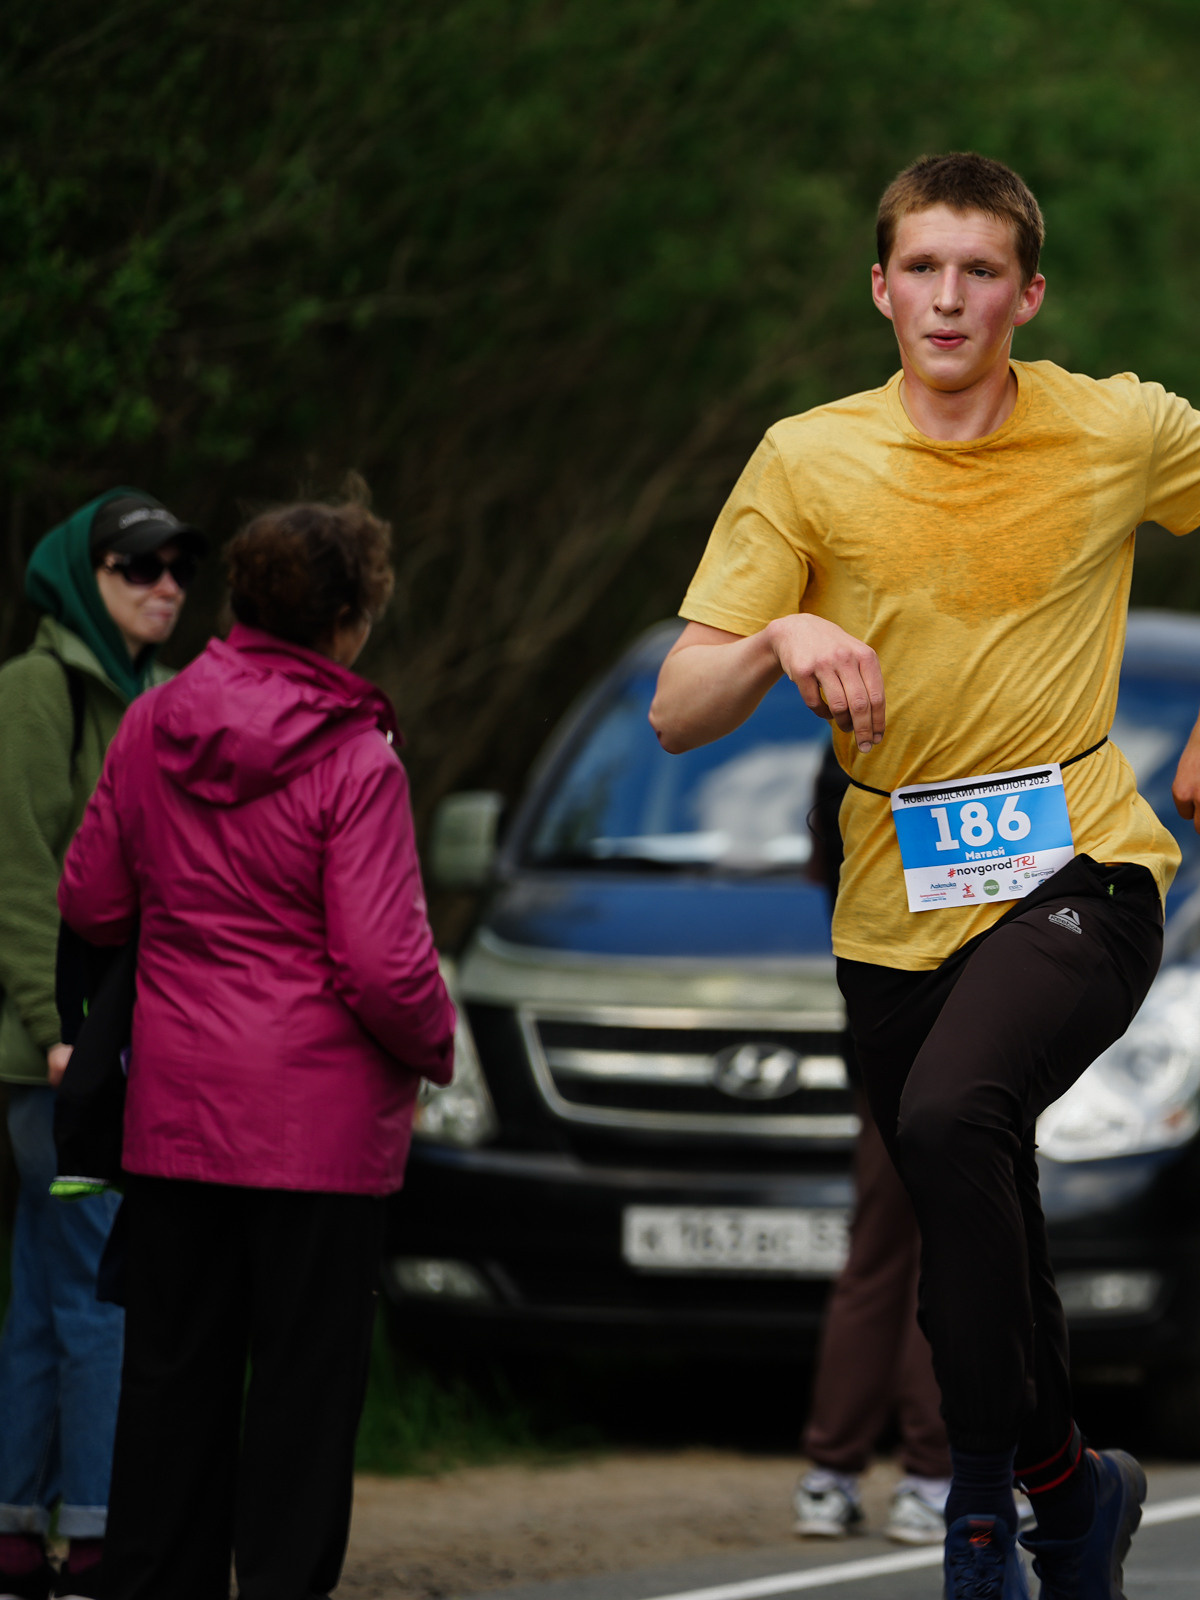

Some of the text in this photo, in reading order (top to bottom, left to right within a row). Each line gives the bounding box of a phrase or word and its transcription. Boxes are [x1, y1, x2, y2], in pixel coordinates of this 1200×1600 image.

[1029, 775, 1051, 787] 2023
[931, 795, 1032, 852] 186
[965, 847, 1006, 861] Матвей
